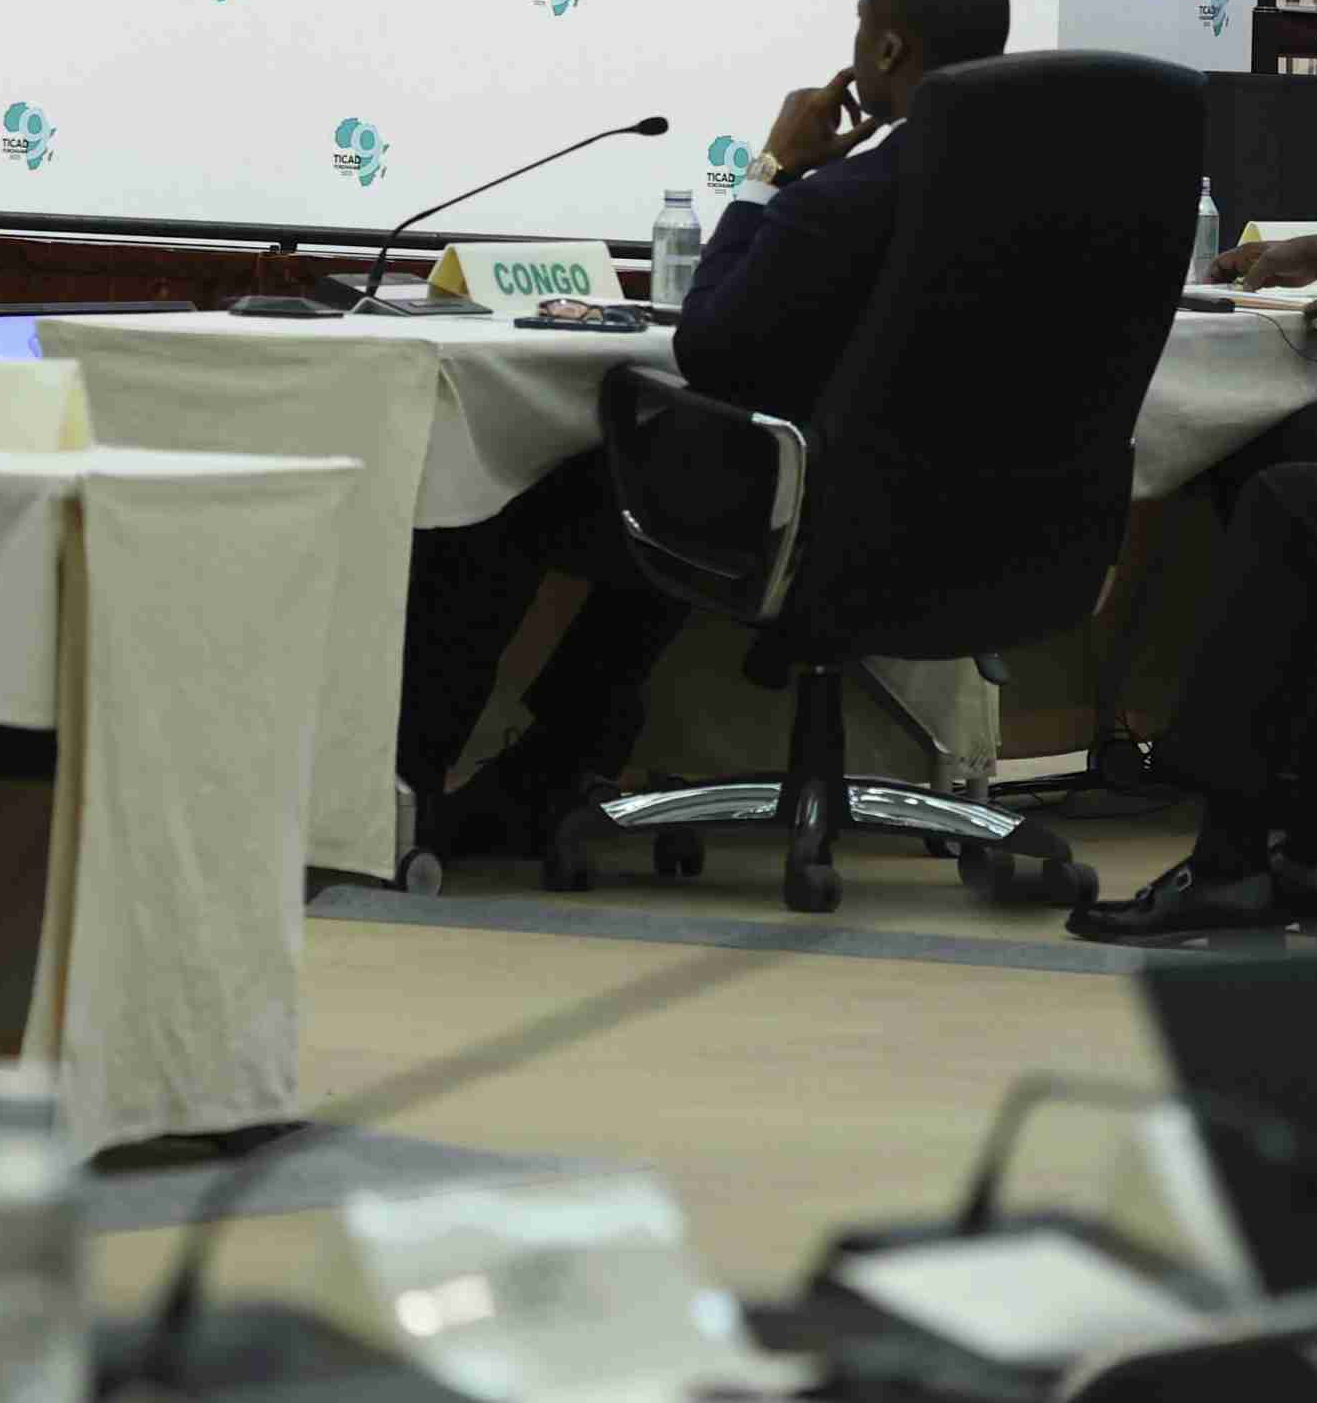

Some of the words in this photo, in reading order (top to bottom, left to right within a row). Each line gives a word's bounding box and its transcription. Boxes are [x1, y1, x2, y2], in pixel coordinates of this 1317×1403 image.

[3, 138, 29, 148] TICAD
[333, 154, 362, 165] TICAD
[707, 172, 736, 183] TICAD
[493, 262, 591, 295] CONGO
